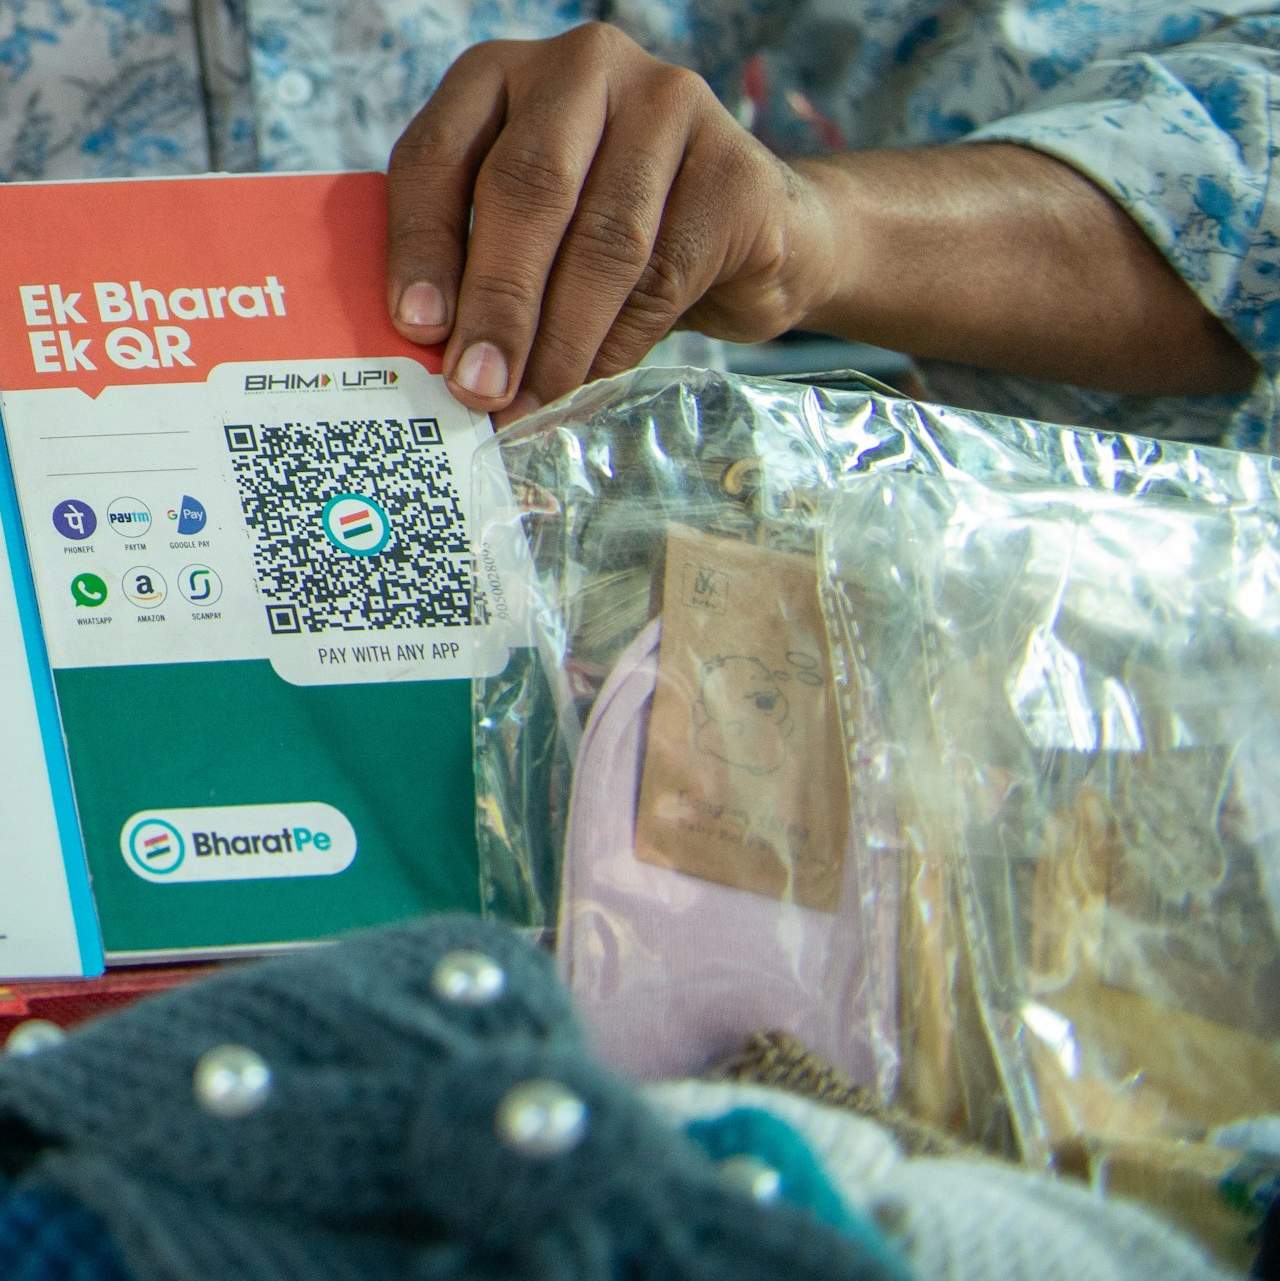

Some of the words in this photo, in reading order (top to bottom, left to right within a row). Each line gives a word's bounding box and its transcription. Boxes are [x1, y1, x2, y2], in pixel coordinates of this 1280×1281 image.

[18, 284, 88, 326] Ek
[93, 276, 287, 323] Bharat
[27, 329, 98, 373] Ek
[104, 326, 197, 370] QR
[244, 373, 320, 391] BHIM
[342, 370, 388, 387] UPI
[183, 508, 204, 522] Pay
[64, 545, 95, 555] PHONEPE
[125, 543, 147, 551] PAYTM
[169, 541, 196, 550] GOOGLE
[198, 540, 210, 549] PAY
[77, 617, 113, 626] WHATSAPP
[137, 614, 166, 623] AMAZON
[192, 612, 222, 621] SCANPAY
[318, 648, 347, 664] PAY
[351, 646, 390, 663] WITH
[397, 644, 425, 661] ANY
[432, 642, 460, 659] APP
[192, 827, 332, 858] BharatPe
